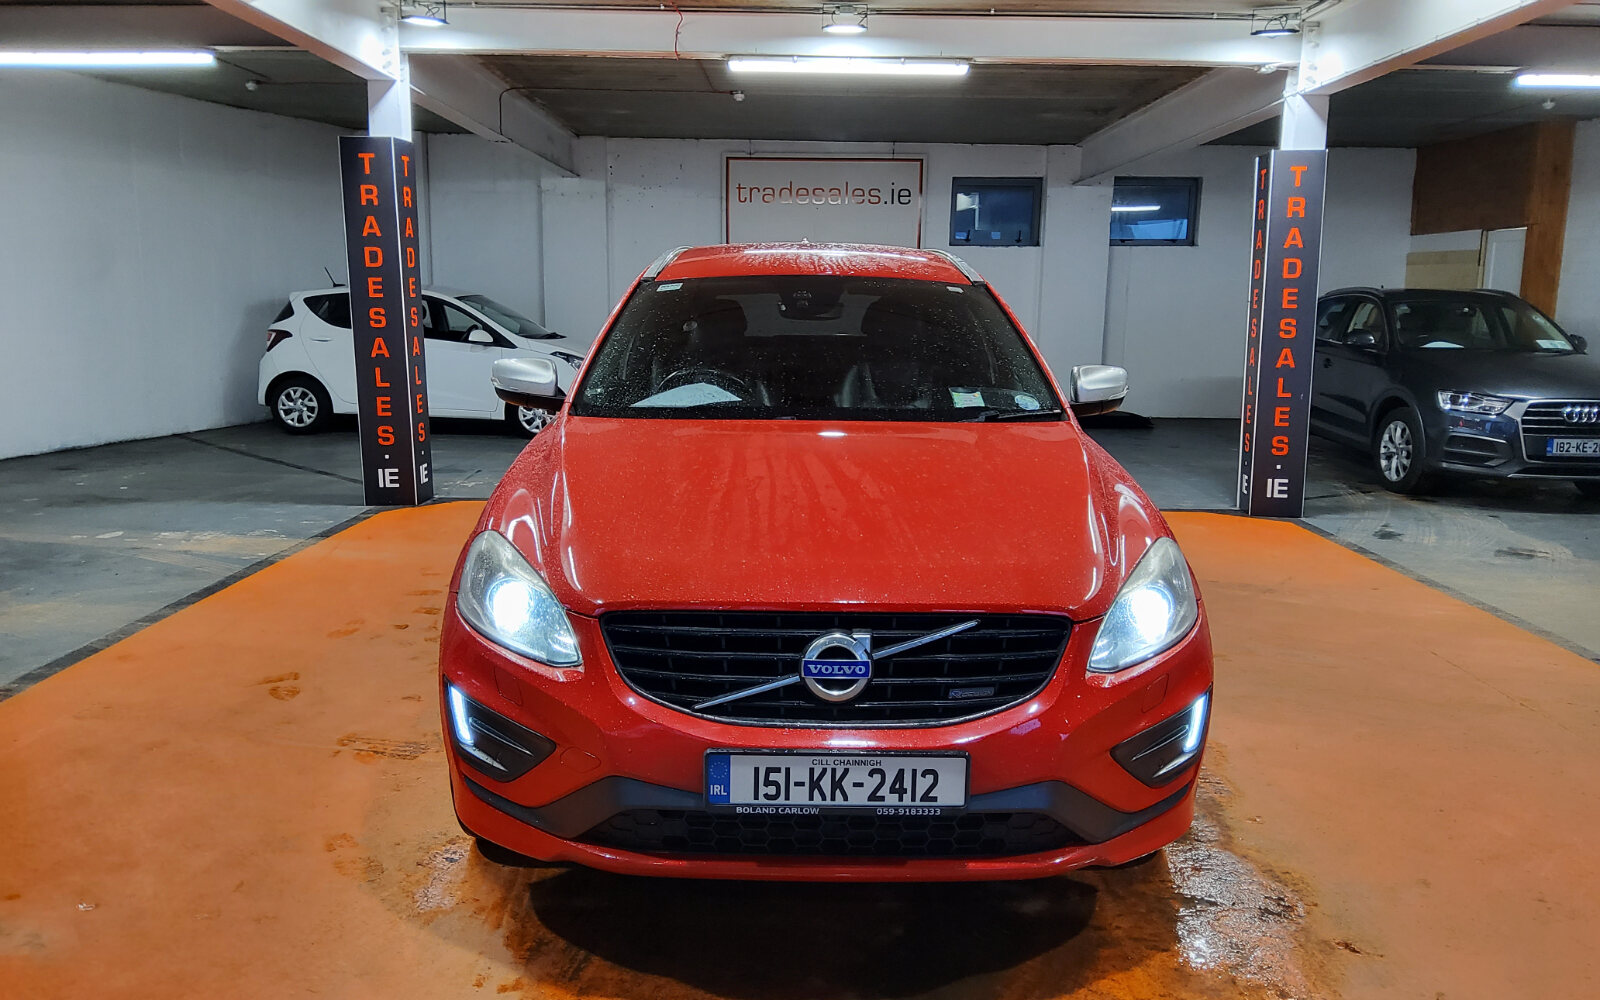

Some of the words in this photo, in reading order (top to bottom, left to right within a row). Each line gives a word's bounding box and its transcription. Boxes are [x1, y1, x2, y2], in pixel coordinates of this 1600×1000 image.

[736, 180, 912, 205] tradesales.ie
[1555, 441, 1600, 453] 182-KE-2
[807, 664, 866, 675] VOLVO
[811, 758, 832, 766] CILL
[833, 759, 882, 767] CHAINNIGH
[709, 784, 728, 796] IRL
[753, 766, 939, 803] 151-KK-2412
[736, 806, 777, 815] BOLAND
[778, 807, 820, 815] CARLOW
[876, 808, 941, 816] 059-9183333
